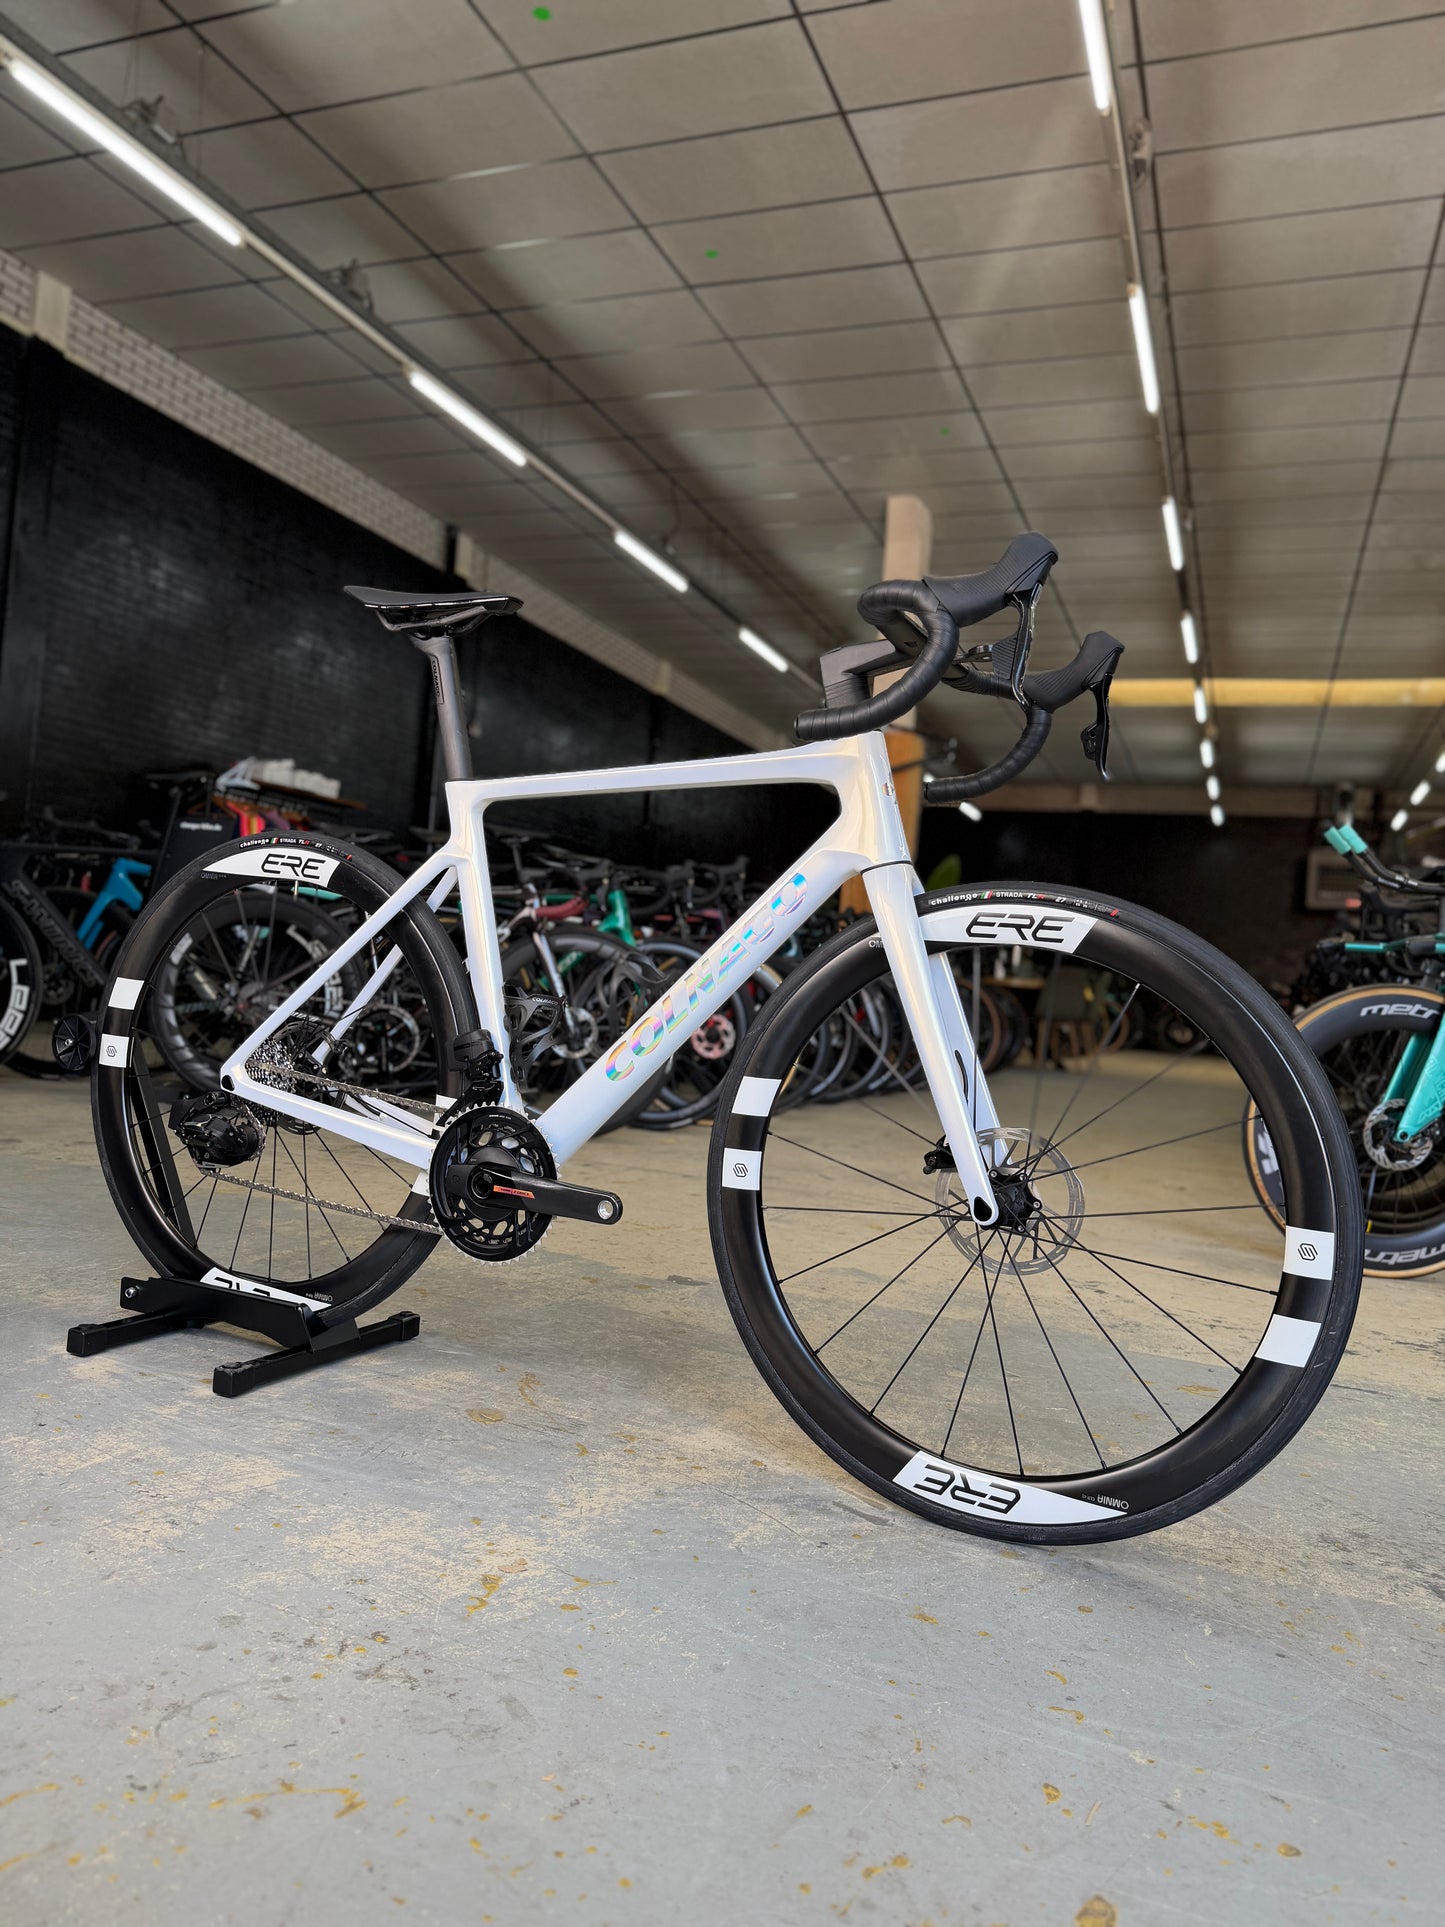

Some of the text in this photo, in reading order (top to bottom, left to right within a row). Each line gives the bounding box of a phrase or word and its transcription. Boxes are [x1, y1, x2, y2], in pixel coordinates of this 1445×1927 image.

[240, 838, 269, 849] challenge
[261, 853, 326, 879] ERE
[930, 893, 978, 906] challenge
[966, 912, 1075, 943] ERE
[604, 872, 808, 1082] COLNAGO
[1360, 1003, 1442, 1019] metr
[913, 1463, 1021, 1514] ERE
[1097, 1494, 1129, 1510] OMNIA
